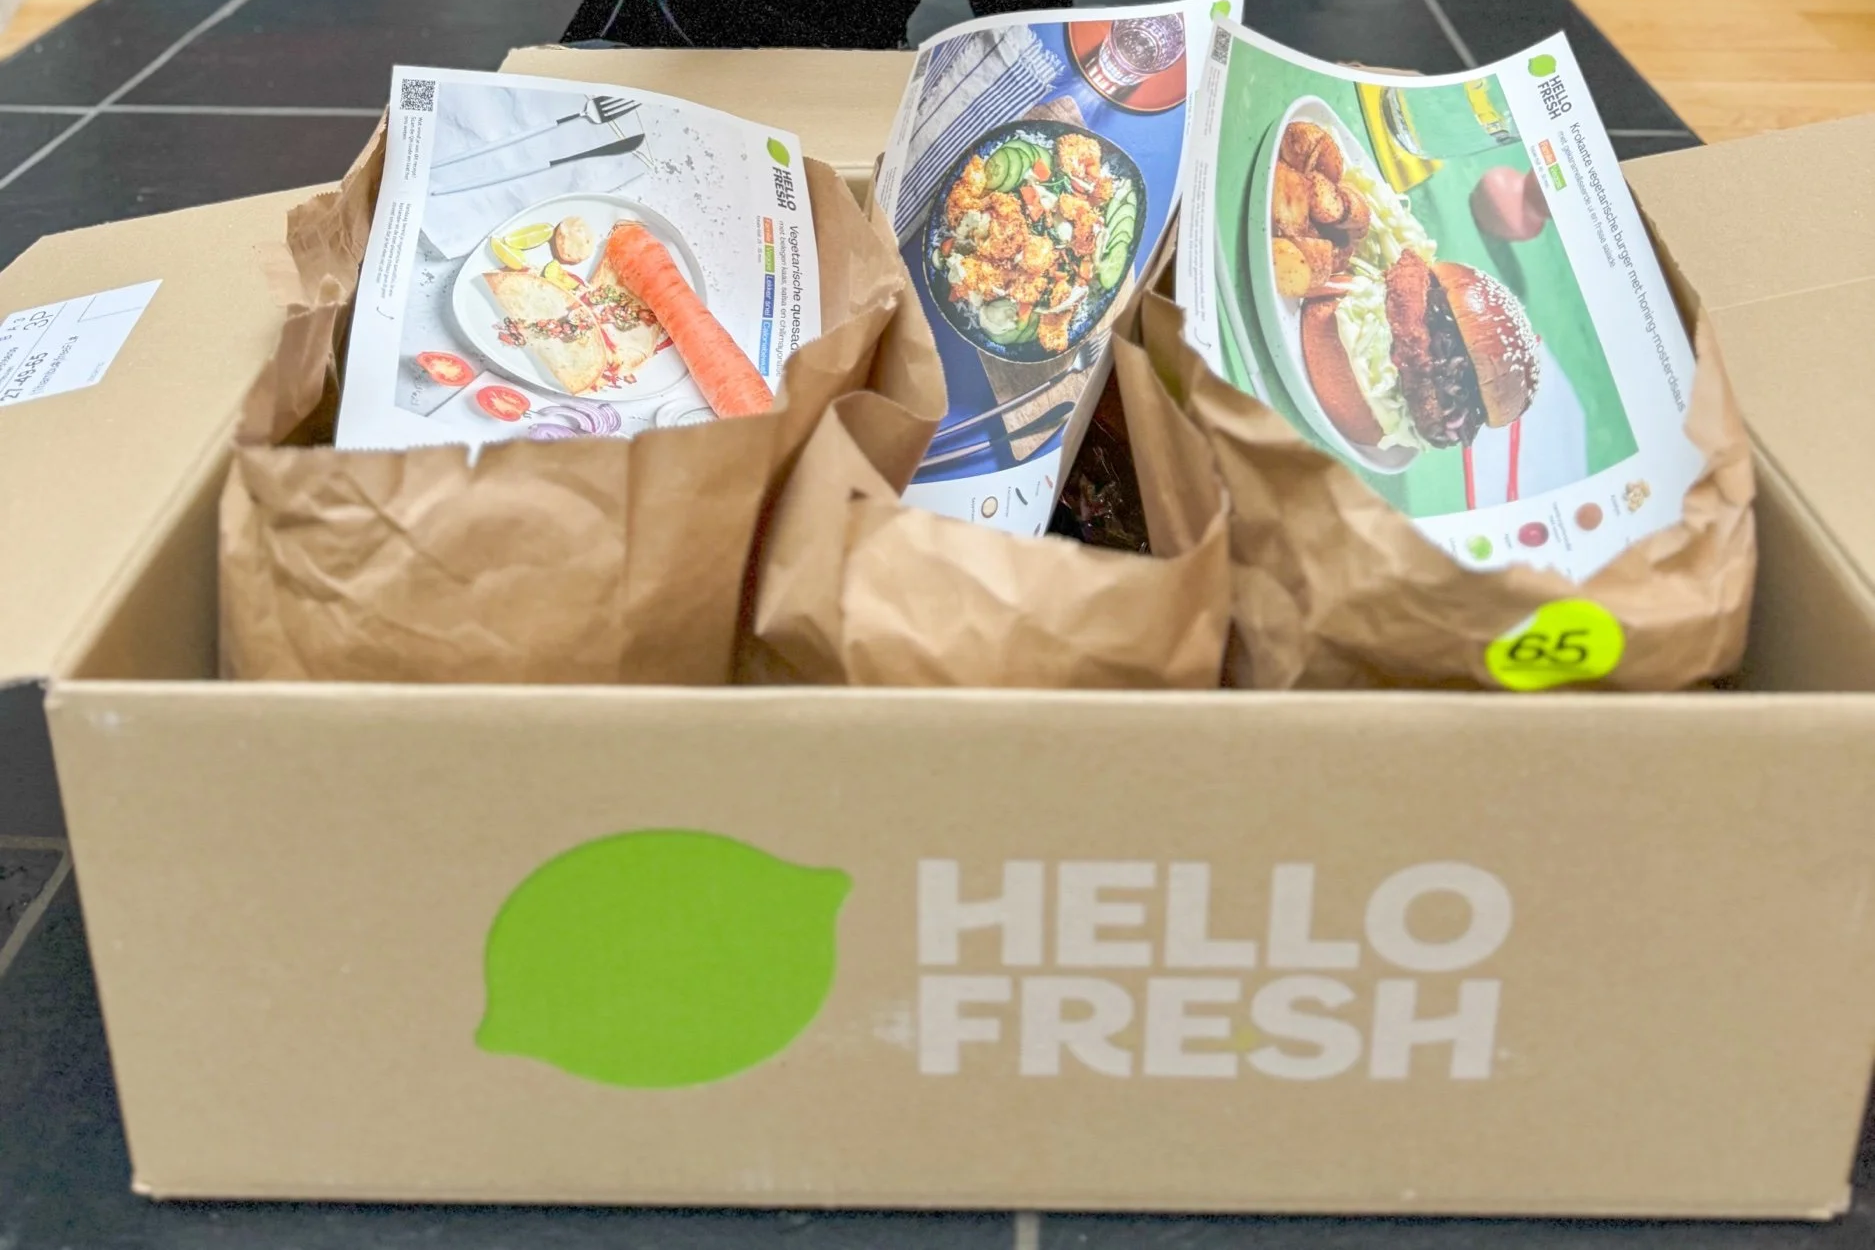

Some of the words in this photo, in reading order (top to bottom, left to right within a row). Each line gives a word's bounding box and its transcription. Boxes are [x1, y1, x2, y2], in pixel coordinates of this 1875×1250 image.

[1537, 81, 1562, 120] FRESH
[1548, 75, 1572, 113] HELLO
[772, 165, 786, 209] FRESH
[782, 169, 796, 211] HELLO
[788, 225, 802, 301] Vegetarische
[1570, 122, 1594, 166] Krokante
[1587, 167, 1621, 232] vegetarische
[1613, 230, 1634, 269] burger
[1627, 268, 1644, 293] met
[1636, 291, 1688, 412] honing-mosterdsaus
[23, 311, 54, 331] 3P
[789, 304, 800, 353] quesad
[0, 352, 49, 402] 27-49-65
[1507, 627, 1590, 664] 65
[917, 858, 1514, 973] HELLO
[917, 974, 1502, 1081] FRESH
